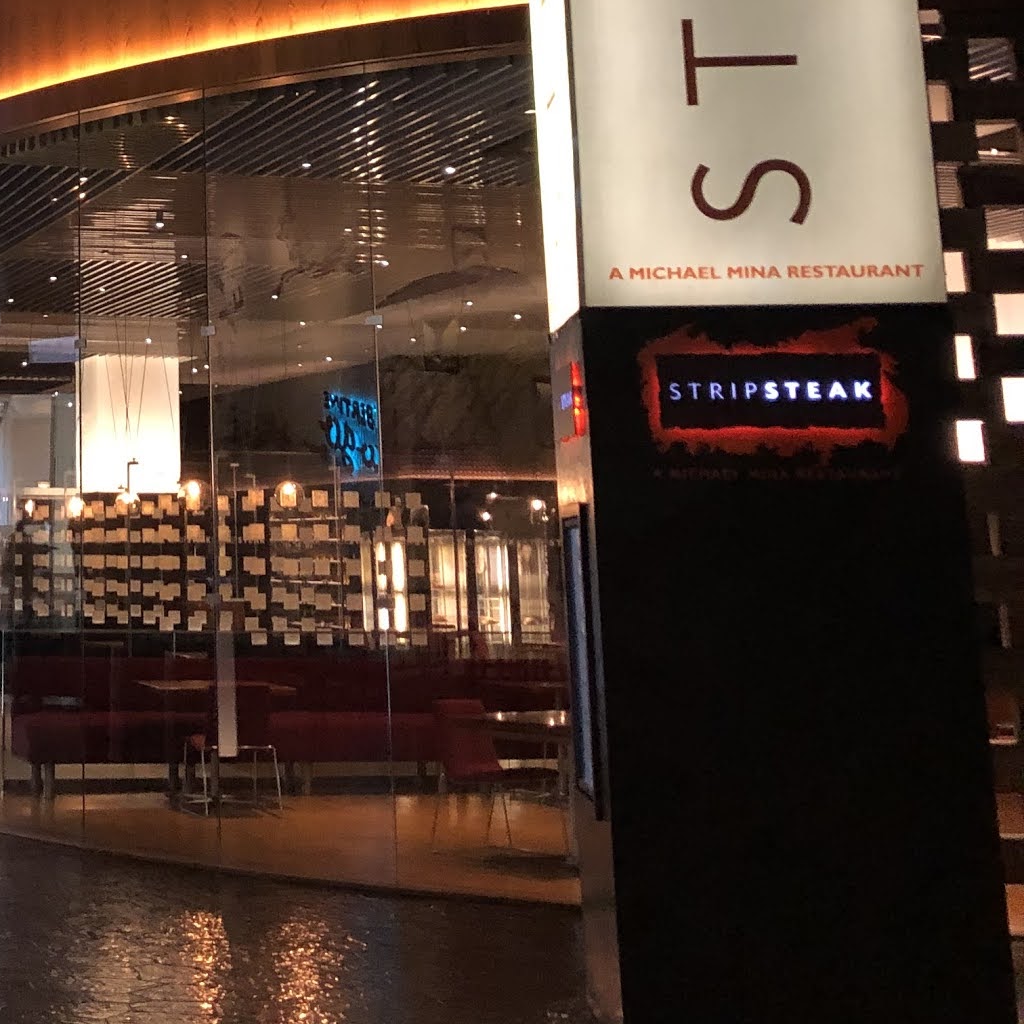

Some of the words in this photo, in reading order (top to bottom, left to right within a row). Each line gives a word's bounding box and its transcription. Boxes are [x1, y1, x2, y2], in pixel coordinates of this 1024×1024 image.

[608, 267, 624, 280] A
[629, 266, 721, 280] MICHAEL
[727, 265, 782, 279] MINA
[787, 264, 924, 278] RESTAURANT
[670, 381, 873, 400] STRIPSTEAK
